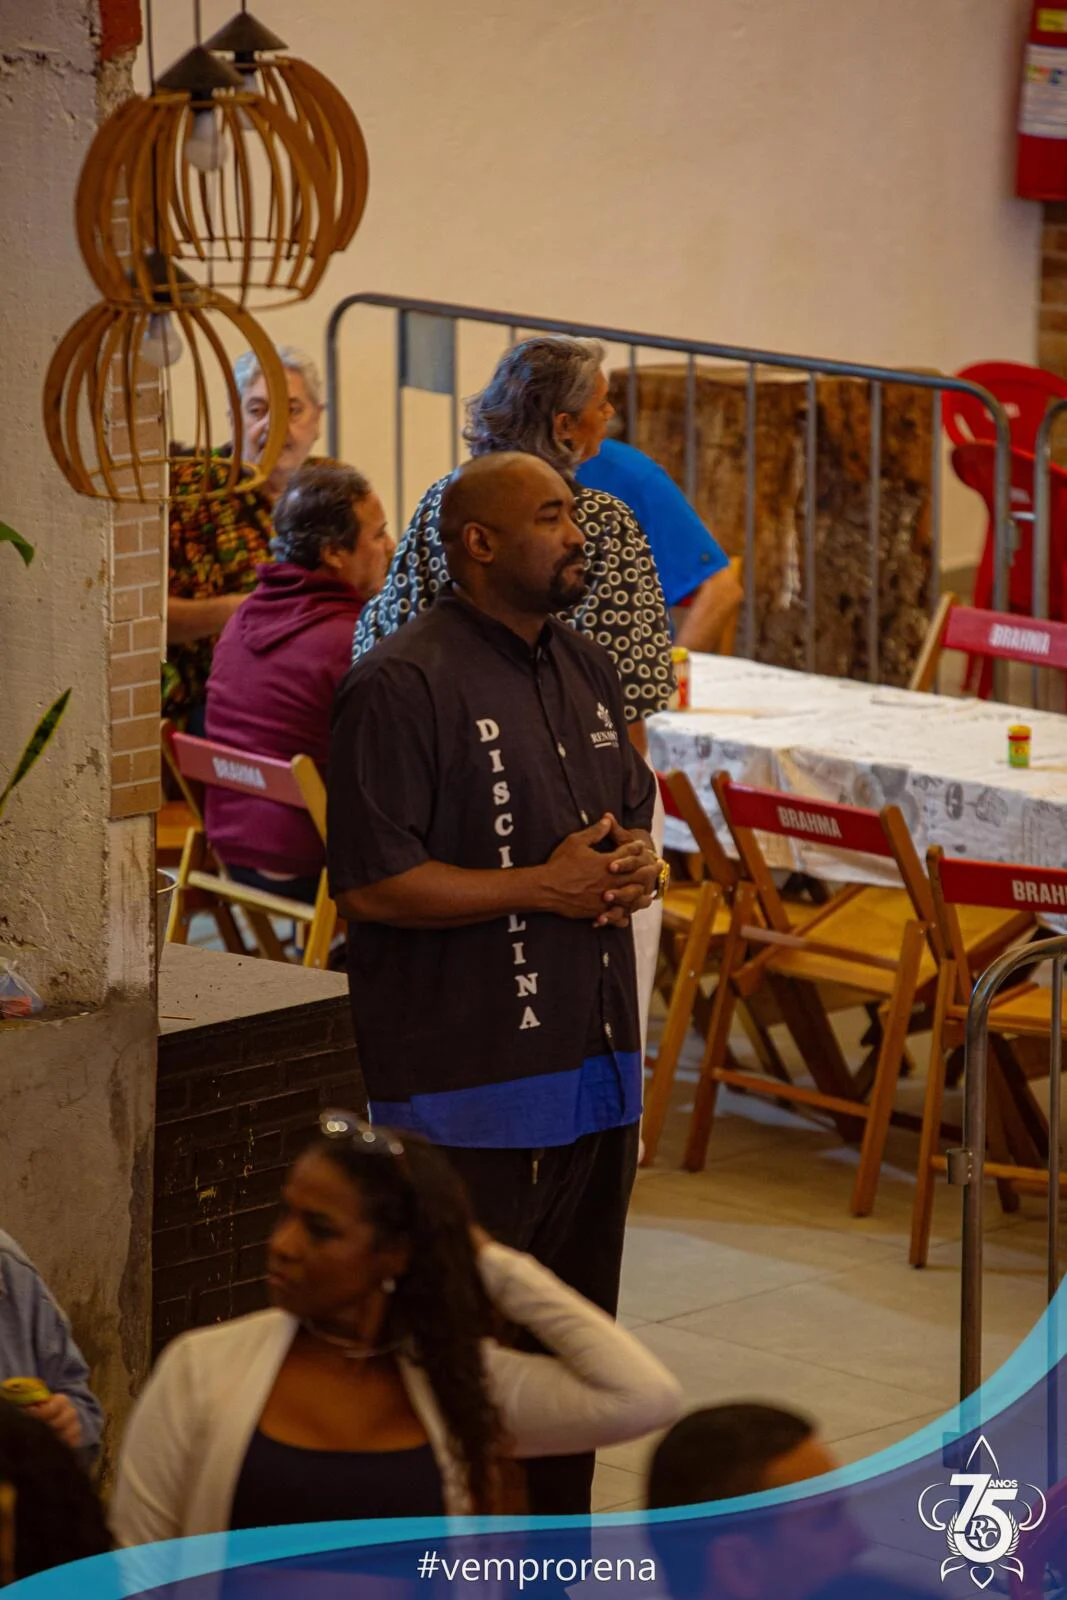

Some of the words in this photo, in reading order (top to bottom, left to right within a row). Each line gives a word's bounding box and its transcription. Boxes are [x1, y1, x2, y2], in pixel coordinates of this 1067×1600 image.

[777, 805, 843, 839] BRAHMA
[475, 718, 541, 1031] DISCILINA
[1012, 879, 1067, 906] BRAH
